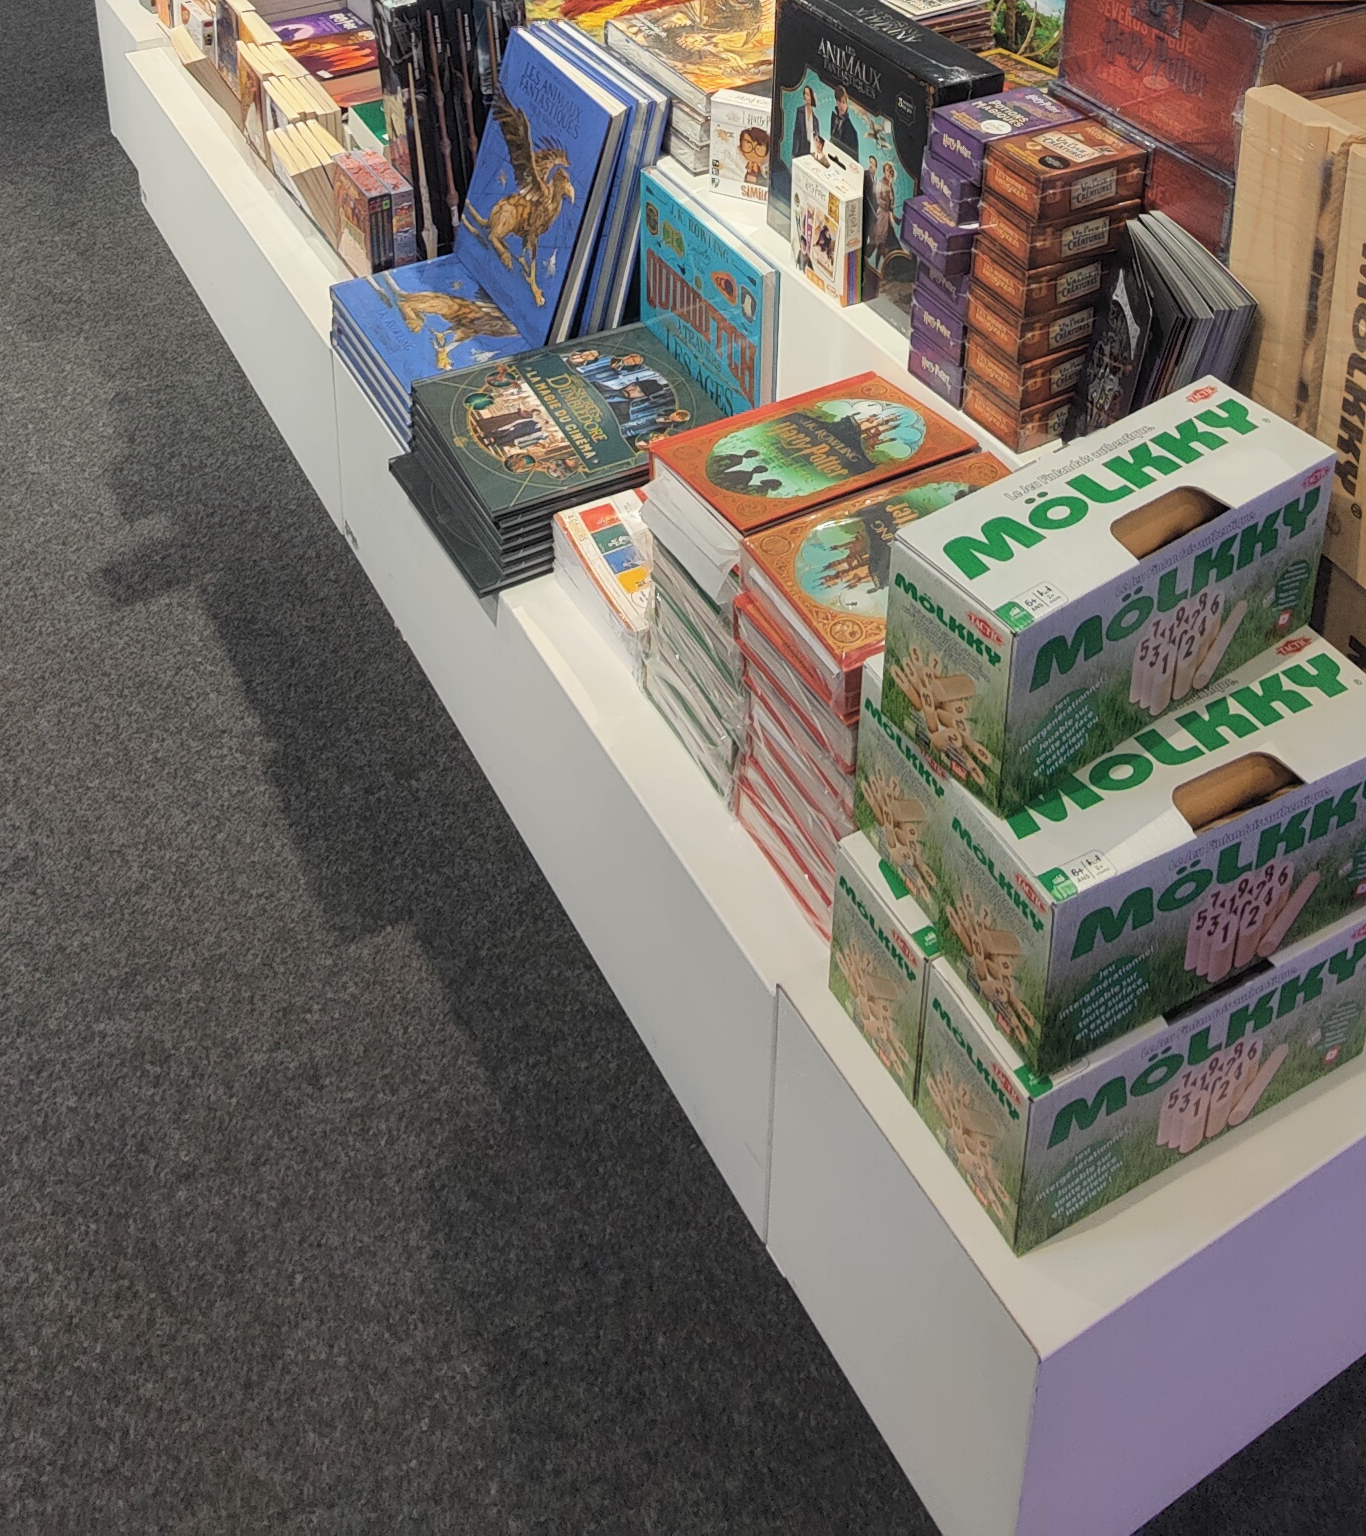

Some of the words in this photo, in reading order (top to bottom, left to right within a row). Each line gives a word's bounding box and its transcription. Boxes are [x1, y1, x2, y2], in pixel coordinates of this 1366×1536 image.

[524, 63, 540, 85] LES
[542, 80, 583, 122] ANIMAUX
[818, 38, 882, 92] ANIMAUX
[519, 75, 580, 140] FANTASTIQUES
[988, 98, 1029, 123] POTIONS
[646, 249, 757, 411] QUIDDITCH
[546, 374, 608, 444] DUMBLEDORE
[1186, 385, 1218, 404] TACTIC
[771, 422, 811, 458] Harry
[804, 444, 850, 479] Potter
[943, 398, 1260, 581] MÖLKKY
[894, 571, 1003, 668] MÖLKKY
[1029, 487, 1322, 693] MÖLKKY
[967, 610, 1005, 646] TACTIC
[1276, 636, 1312, 657] TACTIC
[865, 697, 944, 799] MÖLKKY
[952, 816, 1045, 934] MÖLKKY
[839, 875, 917, 984] MÖLKKY
[933, 997, 1020, 1121] MÖLKKY
